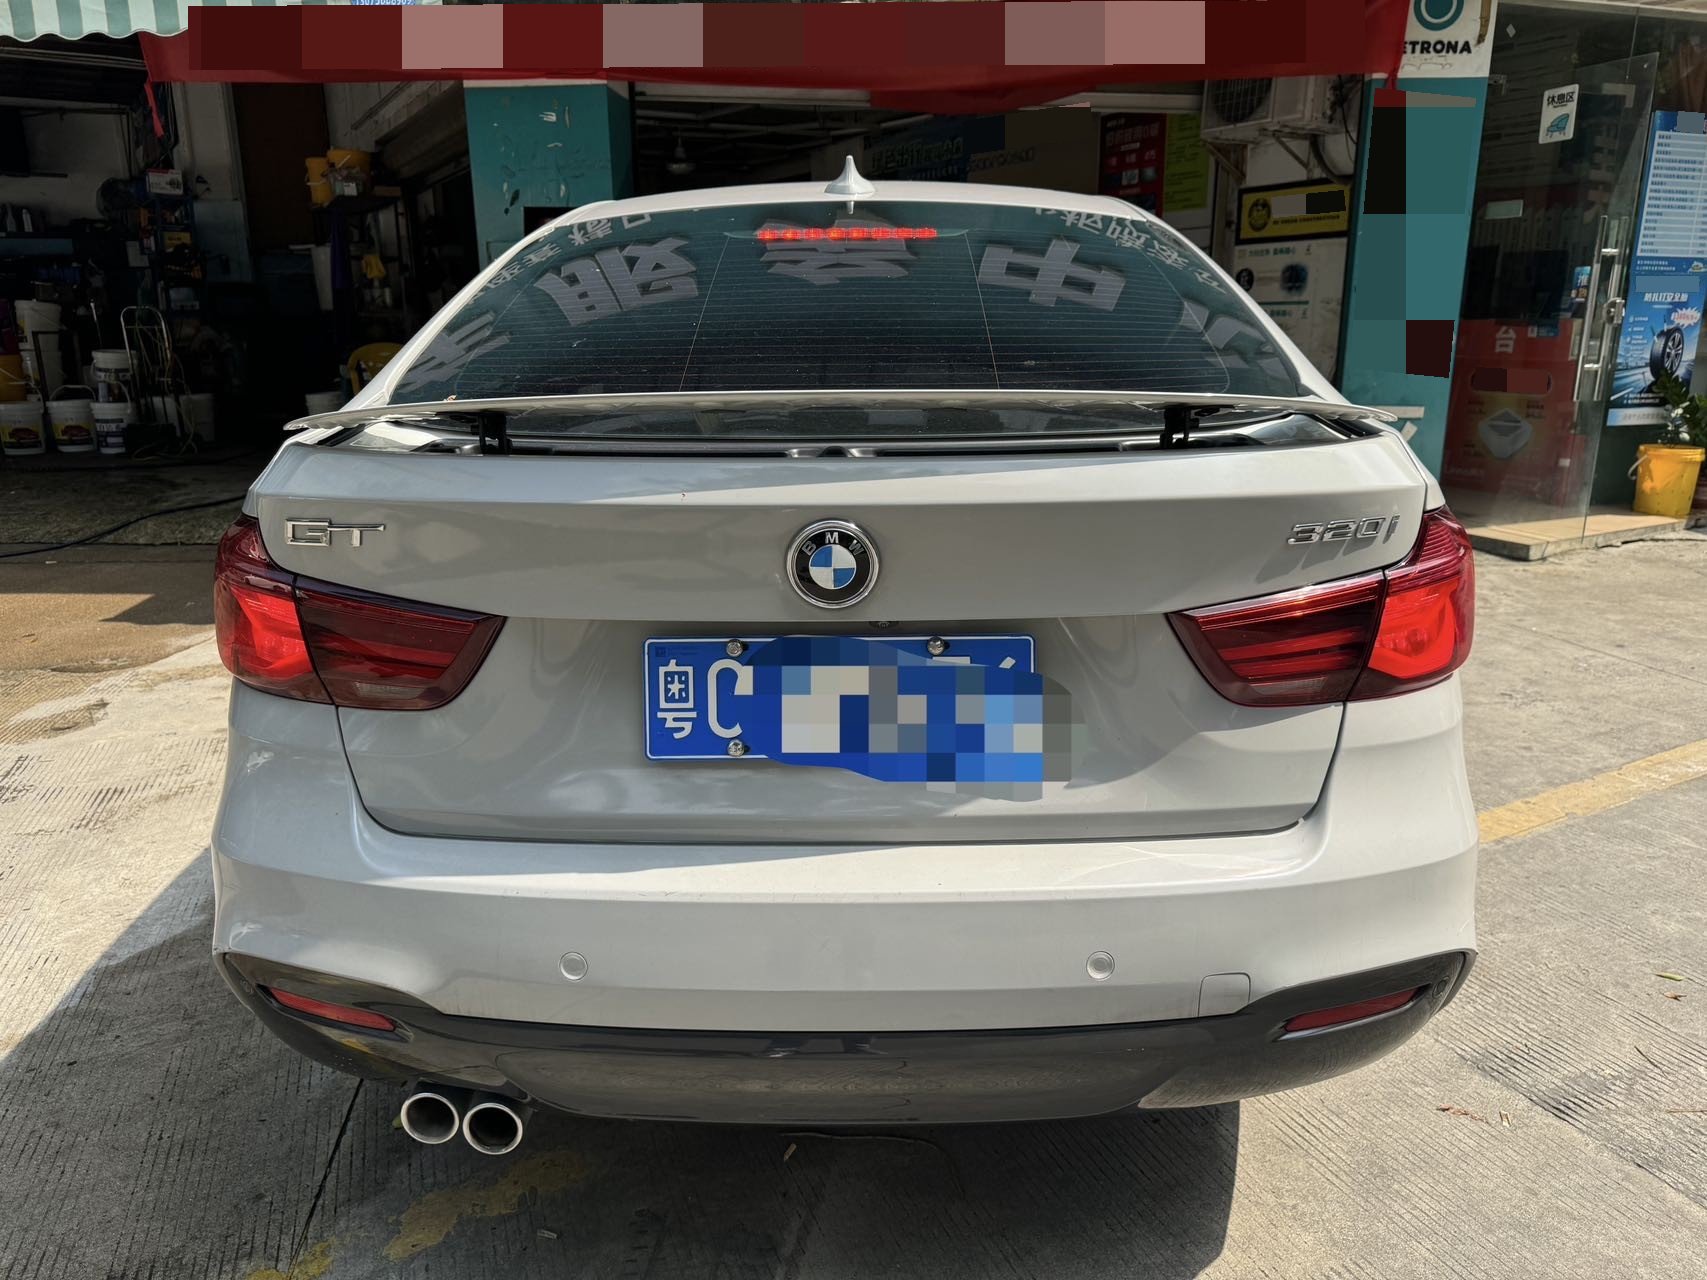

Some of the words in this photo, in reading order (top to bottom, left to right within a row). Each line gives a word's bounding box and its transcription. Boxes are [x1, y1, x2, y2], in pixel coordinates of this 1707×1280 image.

[1547, 91, 1576, 107] 休息区
[285, 518, 385, 547] GT
[1287, 514, 1400, 545] 320i
[802, 532, 865, 556] BMW
